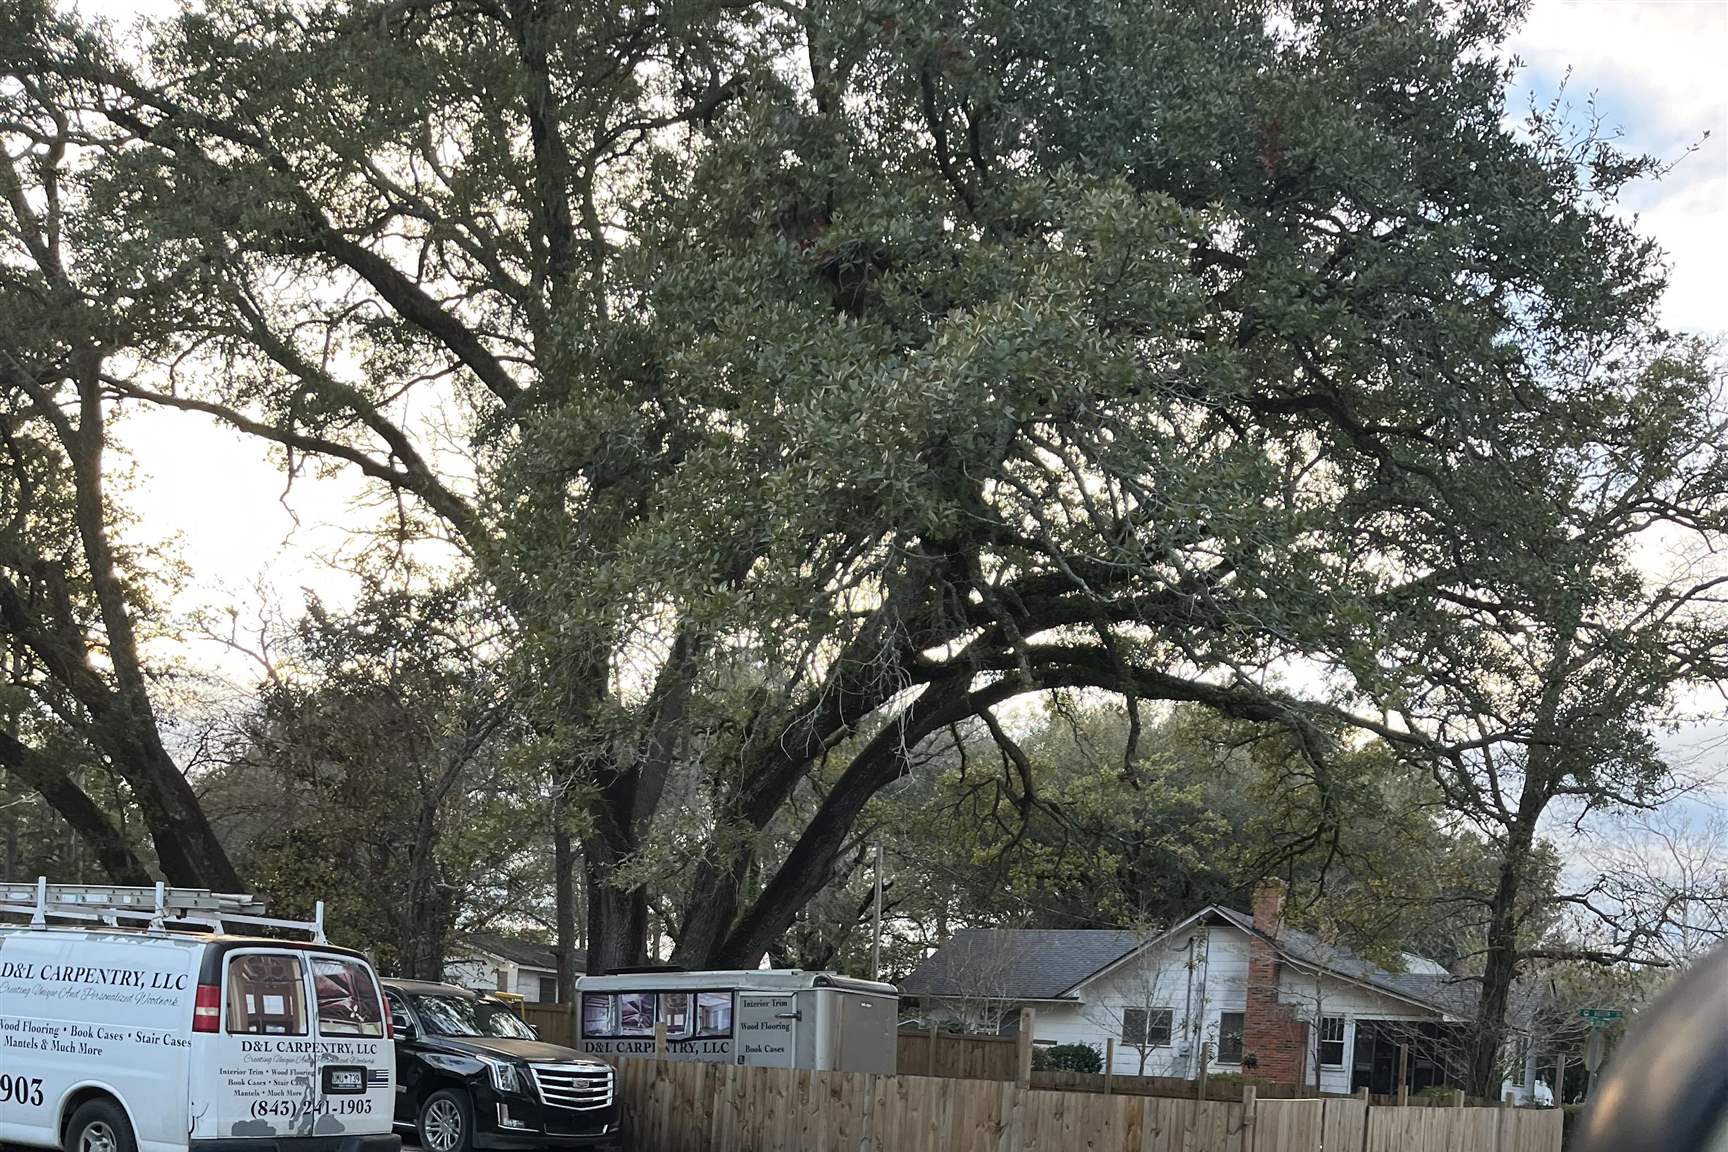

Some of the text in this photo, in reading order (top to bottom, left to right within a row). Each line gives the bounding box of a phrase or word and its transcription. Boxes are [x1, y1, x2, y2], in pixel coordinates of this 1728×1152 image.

[1, 962, 188, 990] D&L CARPENTRY, LLC
[22, 1020, 60, 1038] Flooring
[71, 1025, 94, 1038] Book
[97, 1027, 123, 1041] Cases
[135, 1031, 160, 1045] Stair
[163, 1033, 192, 1048] Cases
[761, 1021, 790, 1032] Flooring
[4, 1035, 103, 1056] Mantels & Much More
[241, 1041, 377, 1055] D&L CARPENTRY, LLC
[585, 1042, 613, 1053] D&L
[703, 1042, 729, 1054] LLC
[248, 1068, 264, 1076] Trim
[250, 1099, 372, 1119] (843) 241-1903
